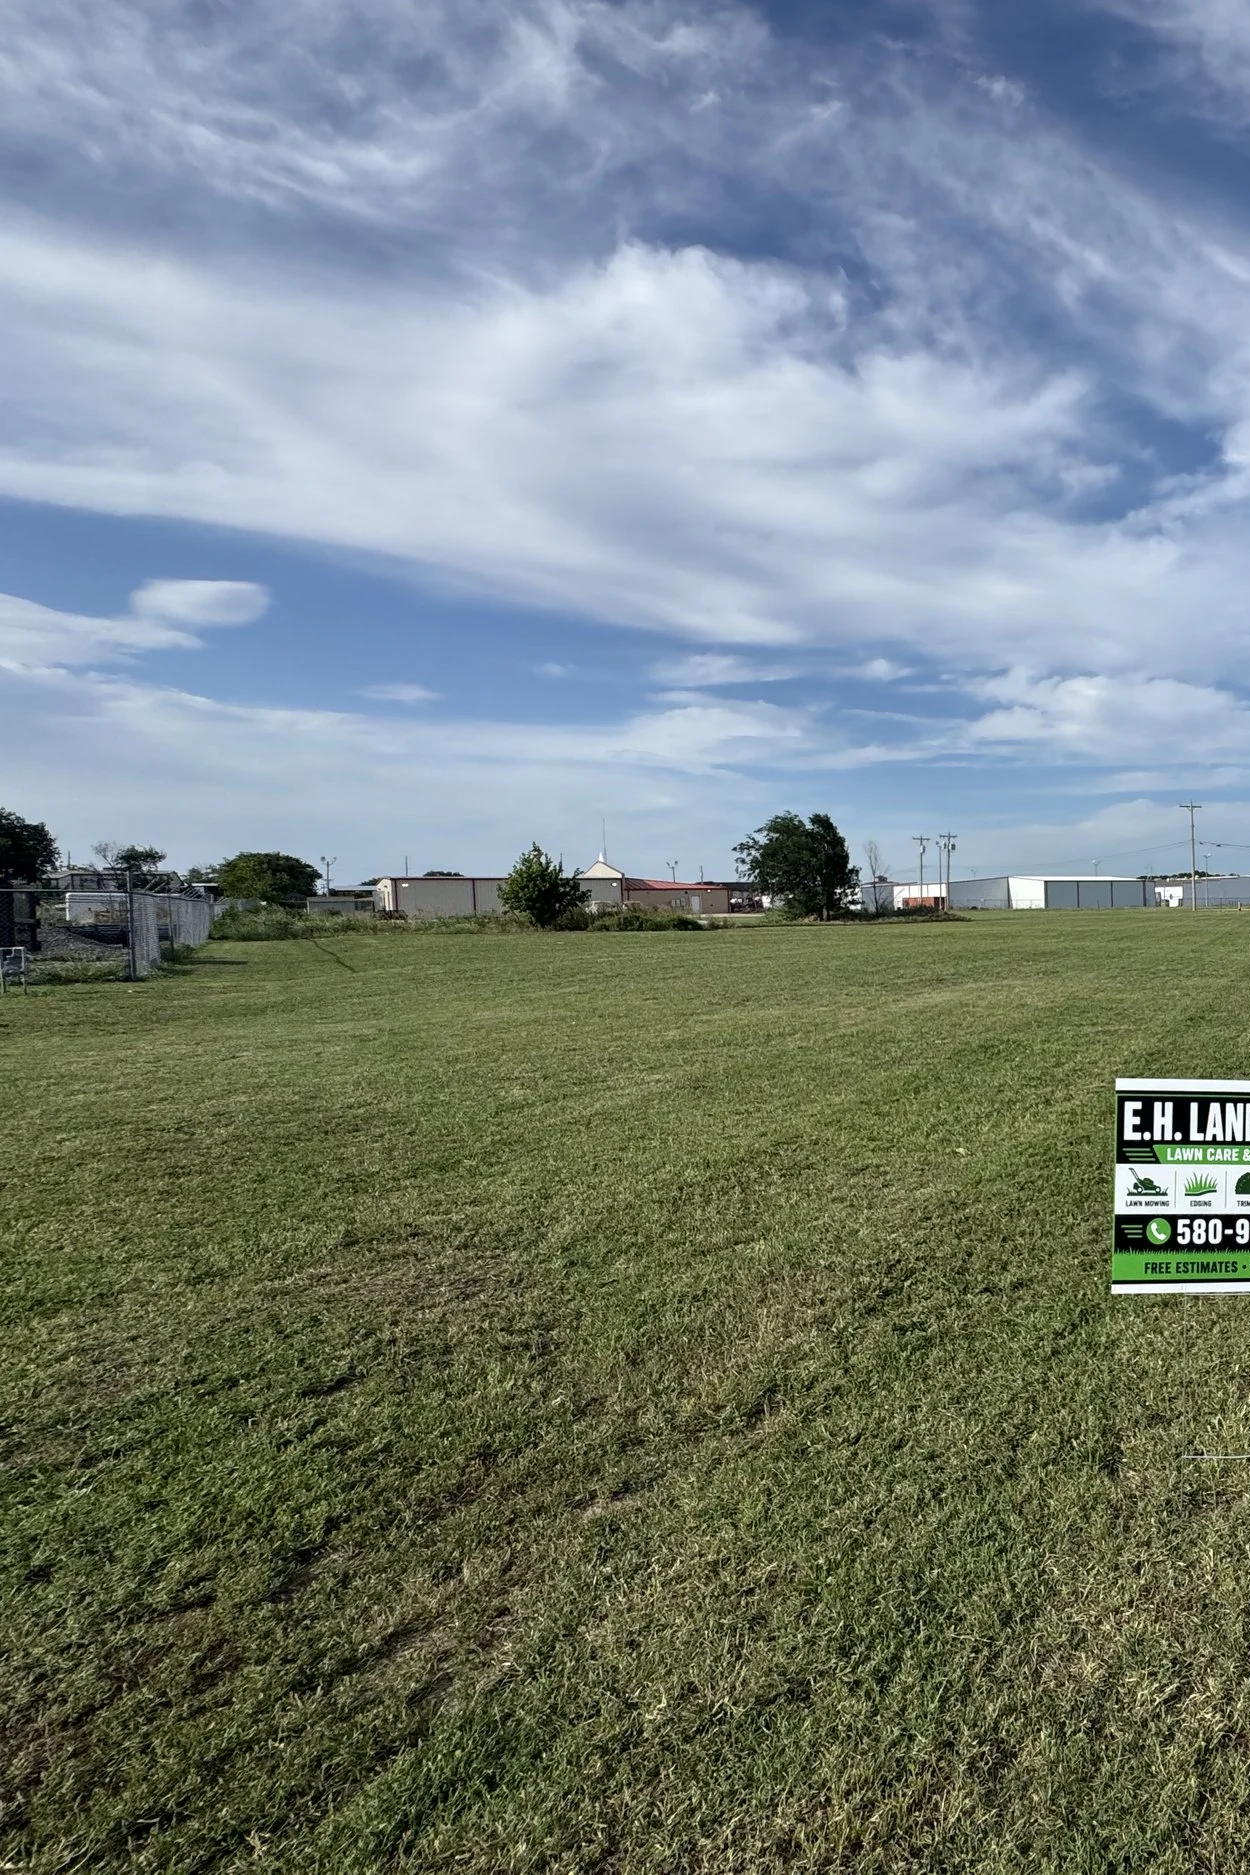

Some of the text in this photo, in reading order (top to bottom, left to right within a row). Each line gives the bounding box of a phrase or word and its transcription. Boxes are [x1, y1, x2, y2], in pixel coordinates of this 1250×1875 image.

[1122, 1101, 1183, 1141] E.H.
[1166, 1147, 1203, 1161] LAWN
[1206, 1148, 1239, 1162] CARE
[1144, 1262, 1172, 1274] FREE
[1175, 1261, 1238, 1274] ESTIMATES
